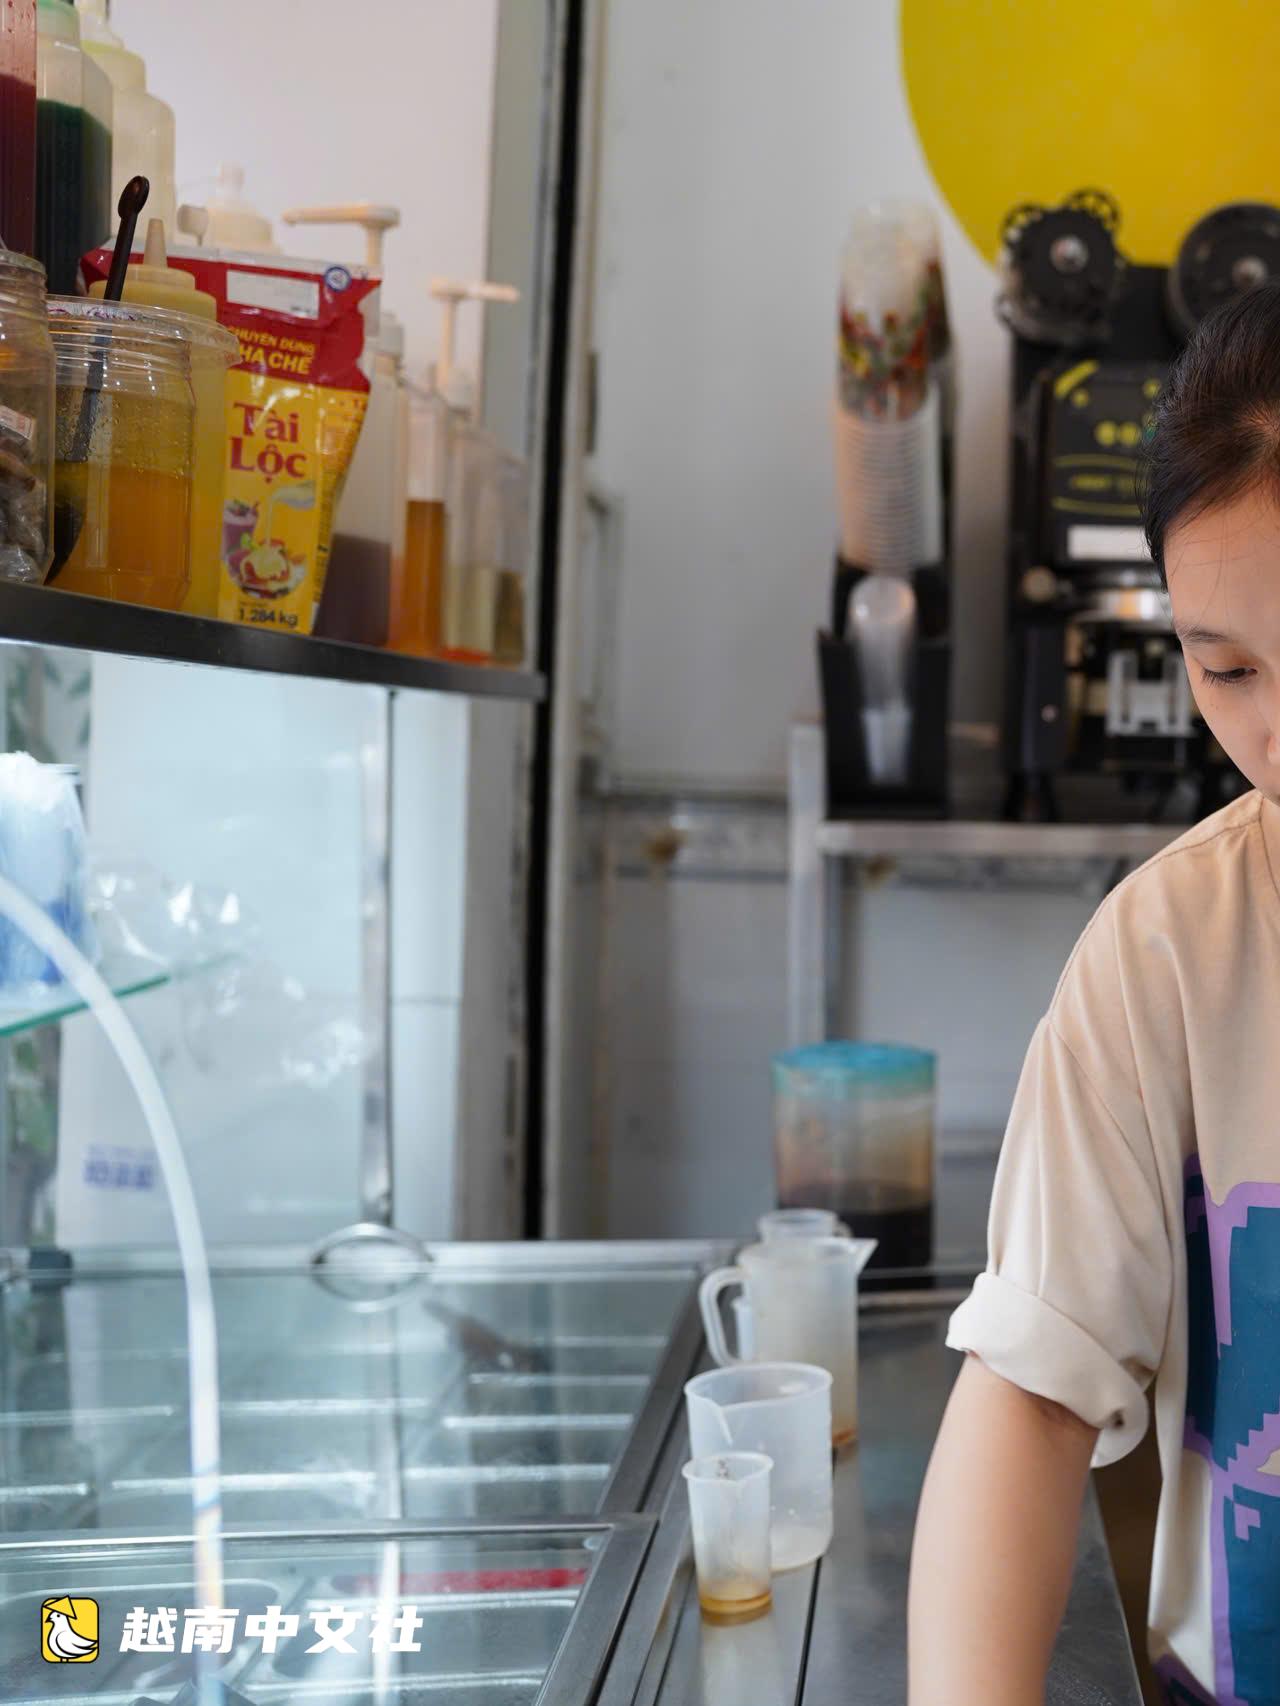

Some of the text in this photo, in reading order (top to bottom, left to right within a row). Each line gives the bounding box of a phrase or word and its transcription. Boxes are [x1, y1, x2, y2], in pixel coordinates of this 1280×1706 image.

[239, 342, 265, 364] HA
[233, 402, 299, 443] Tài
[230, 436, 307, 484] Lộc
[278, 608, 299, 628] kg
